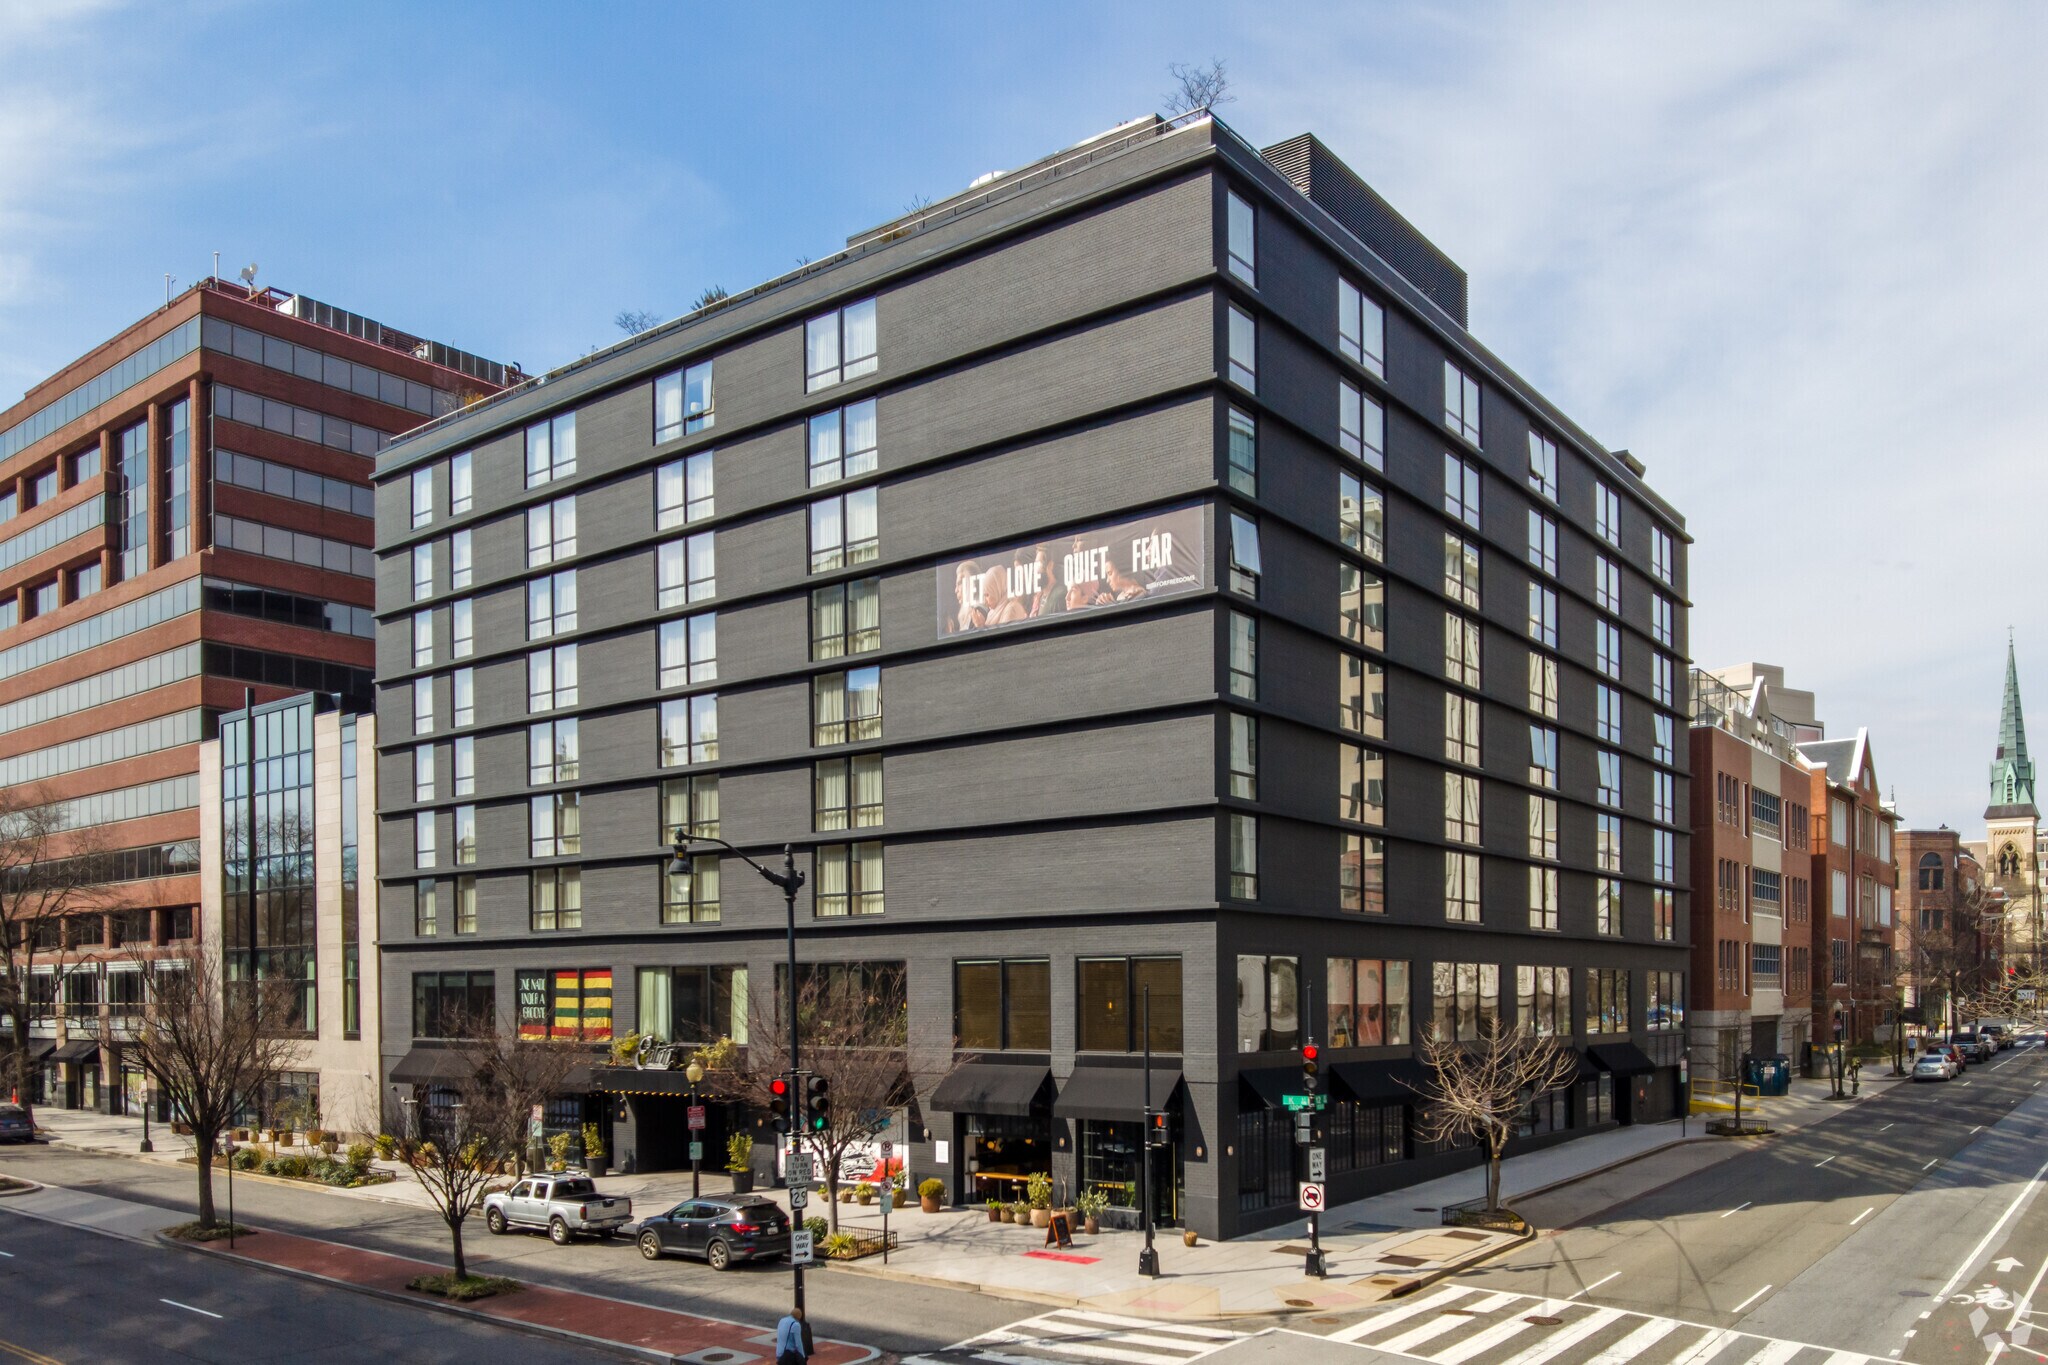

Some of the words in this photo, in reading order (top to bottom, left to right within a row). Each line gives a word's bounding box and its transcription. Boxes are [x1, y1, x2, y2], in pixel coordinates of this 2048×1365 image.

[962, 573, 986, 606] LET
[1007, 561, 1042, 598] LOVE
[1064, 546, 1109, 588] QUIET
[1132, 532, 1172, 573] FEAR
[1312, 1152, 1322, 1161] ONE
[1312, 1161, 1322, 1169] WAY
[794, 1191, 806, 1204] 29
